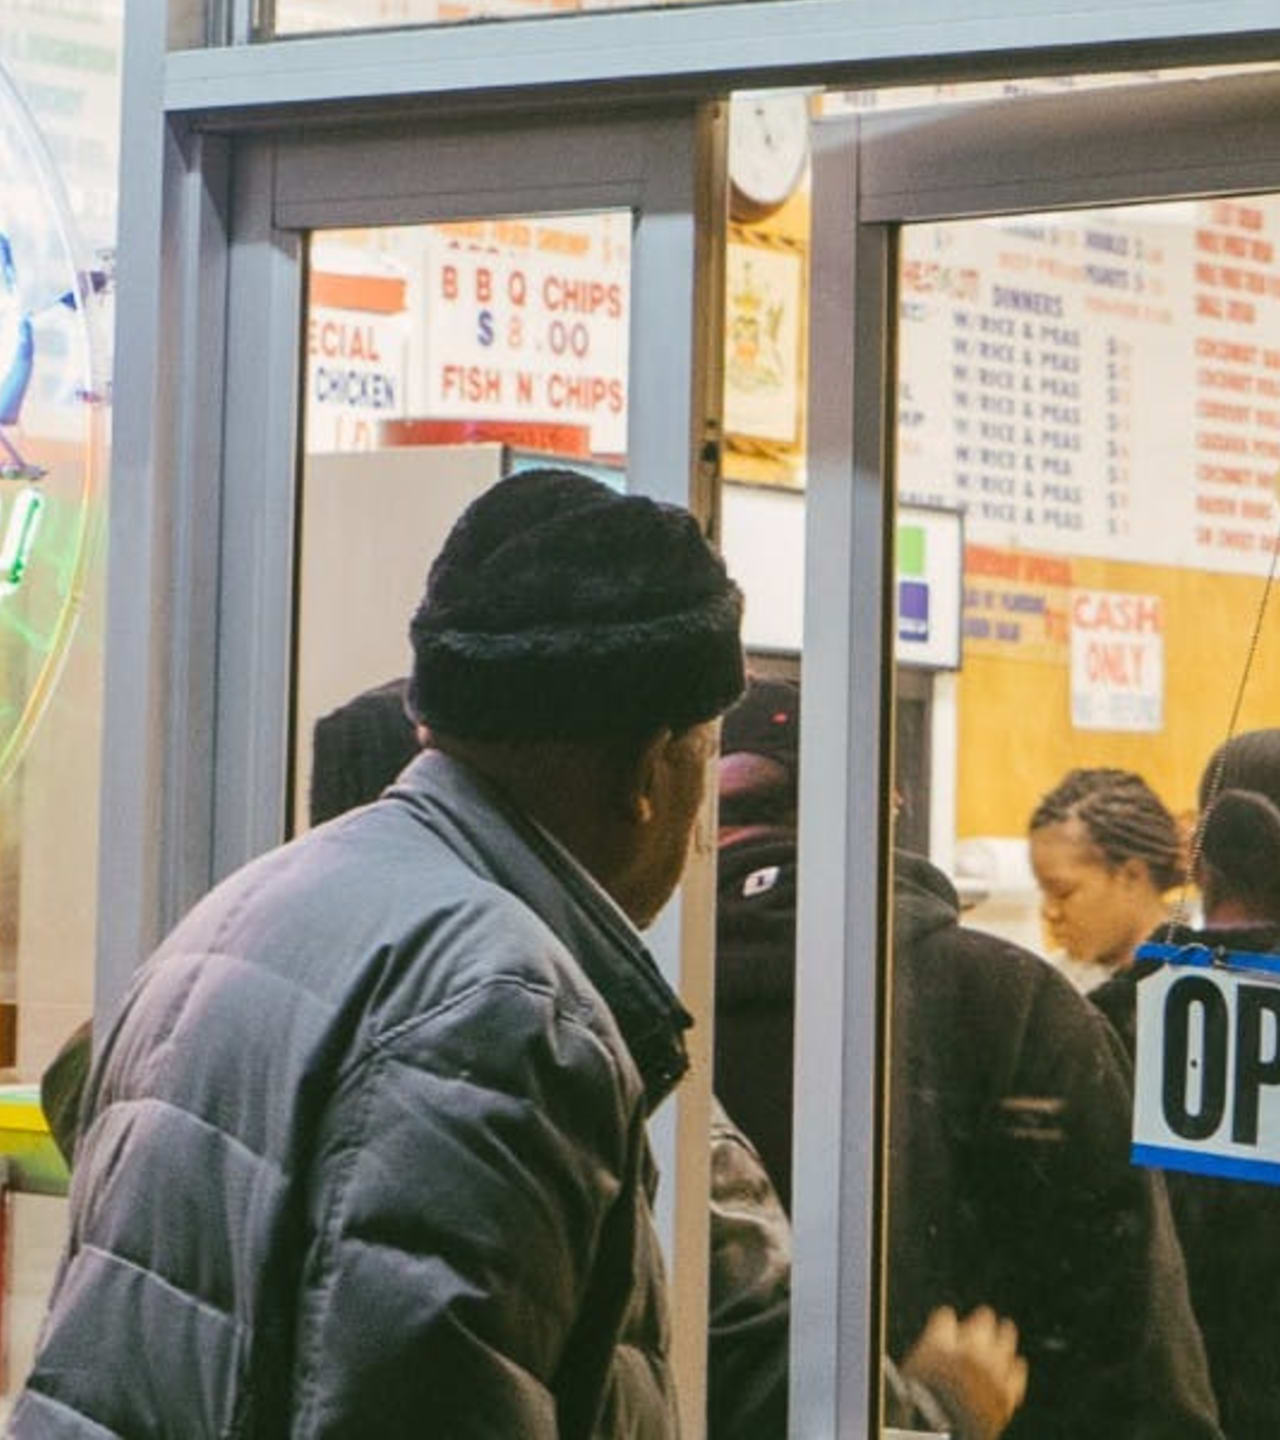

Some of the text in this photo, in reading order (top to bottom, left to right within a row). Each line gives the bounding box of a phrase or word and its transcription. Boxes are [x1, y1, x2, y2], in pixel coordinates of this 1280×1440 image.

[542, 276, 622, 318] CHIPS
[441, 364, 623, 414] FISH N CHIPS
[1073, 594, 1162, 635] CASH
[1086, 643, 1146, 688] ONLY
